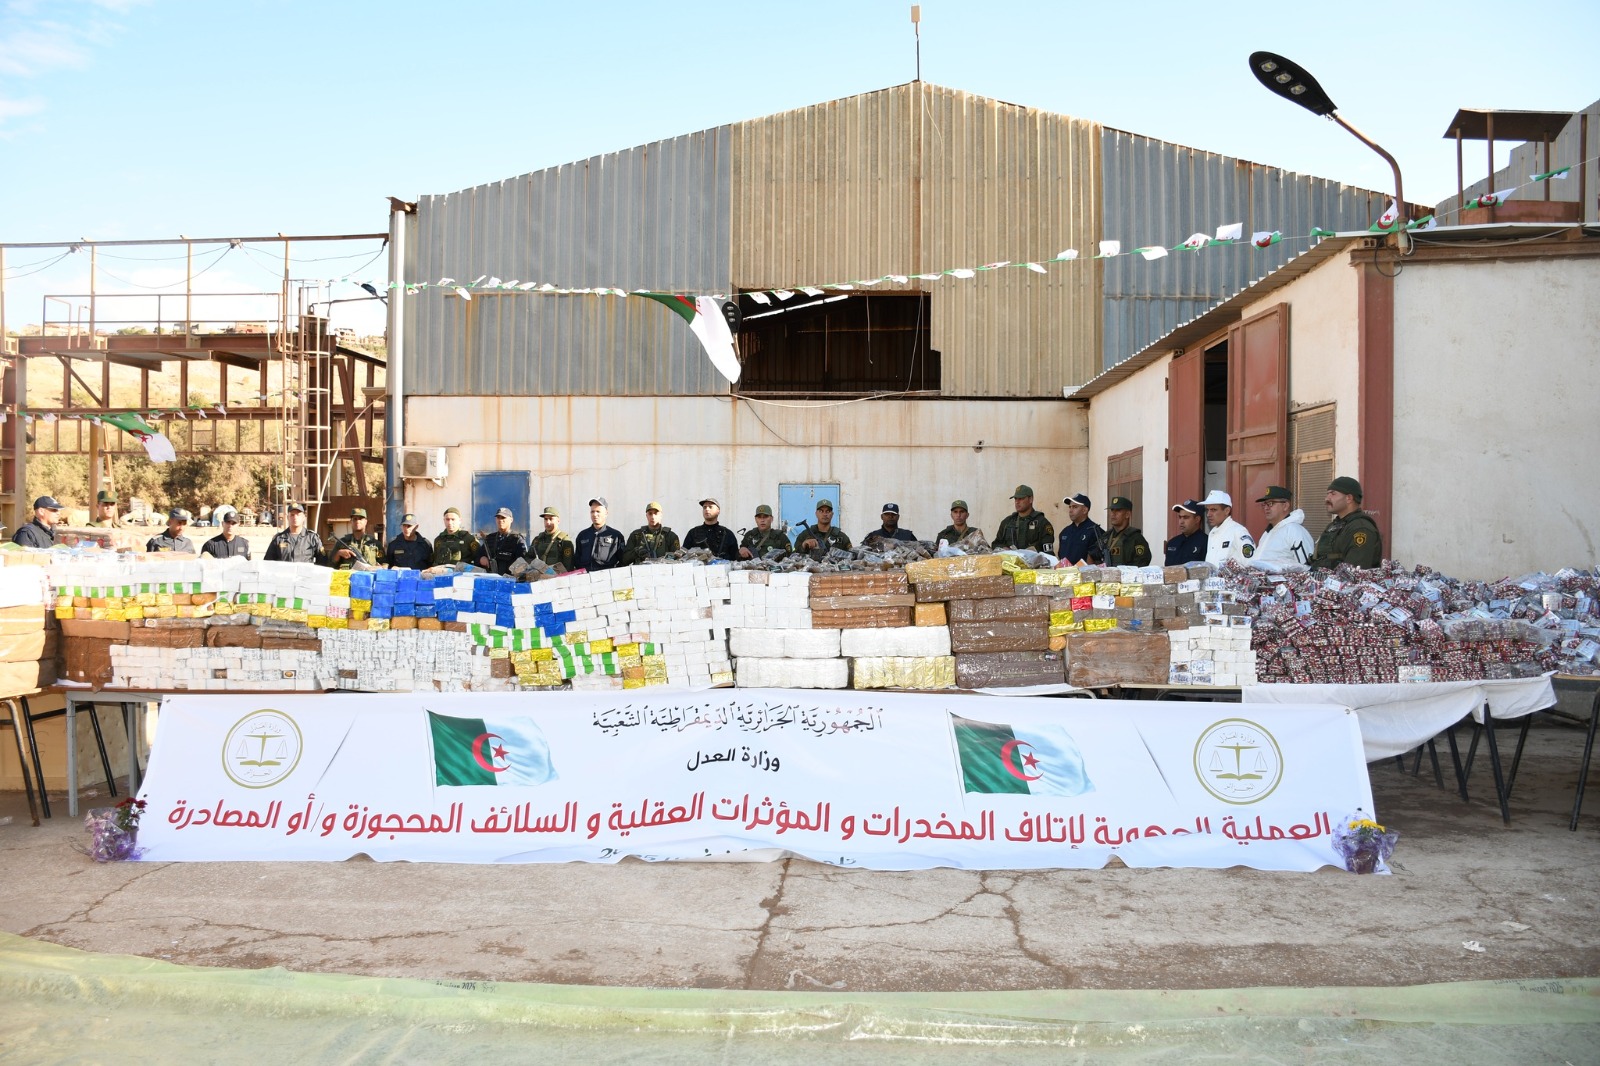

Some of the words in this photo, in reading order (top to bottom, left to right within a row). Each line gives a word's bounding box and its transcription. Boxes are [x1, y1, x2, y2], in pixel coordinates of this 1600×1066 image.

[687, 748, 736, 772] العدل
[742, 745, 780, 772] وزارة
[167, 798, 283, 831] المصادرة
[342, 801, 464, 840] المحجوزة
[470, 802, 578, 834] السلائف
[586, 812, 601, 840] و
[607, 791, 705, 837] العقلية
[711, 794, 831, 835] المؤثرات
[841, 815, 856, 841] و
[863, 806, 995, 843] المخدرات
[1004, 811, 1085, 850] لإتلاف
[1221, 811, 1331, 845] العملية
